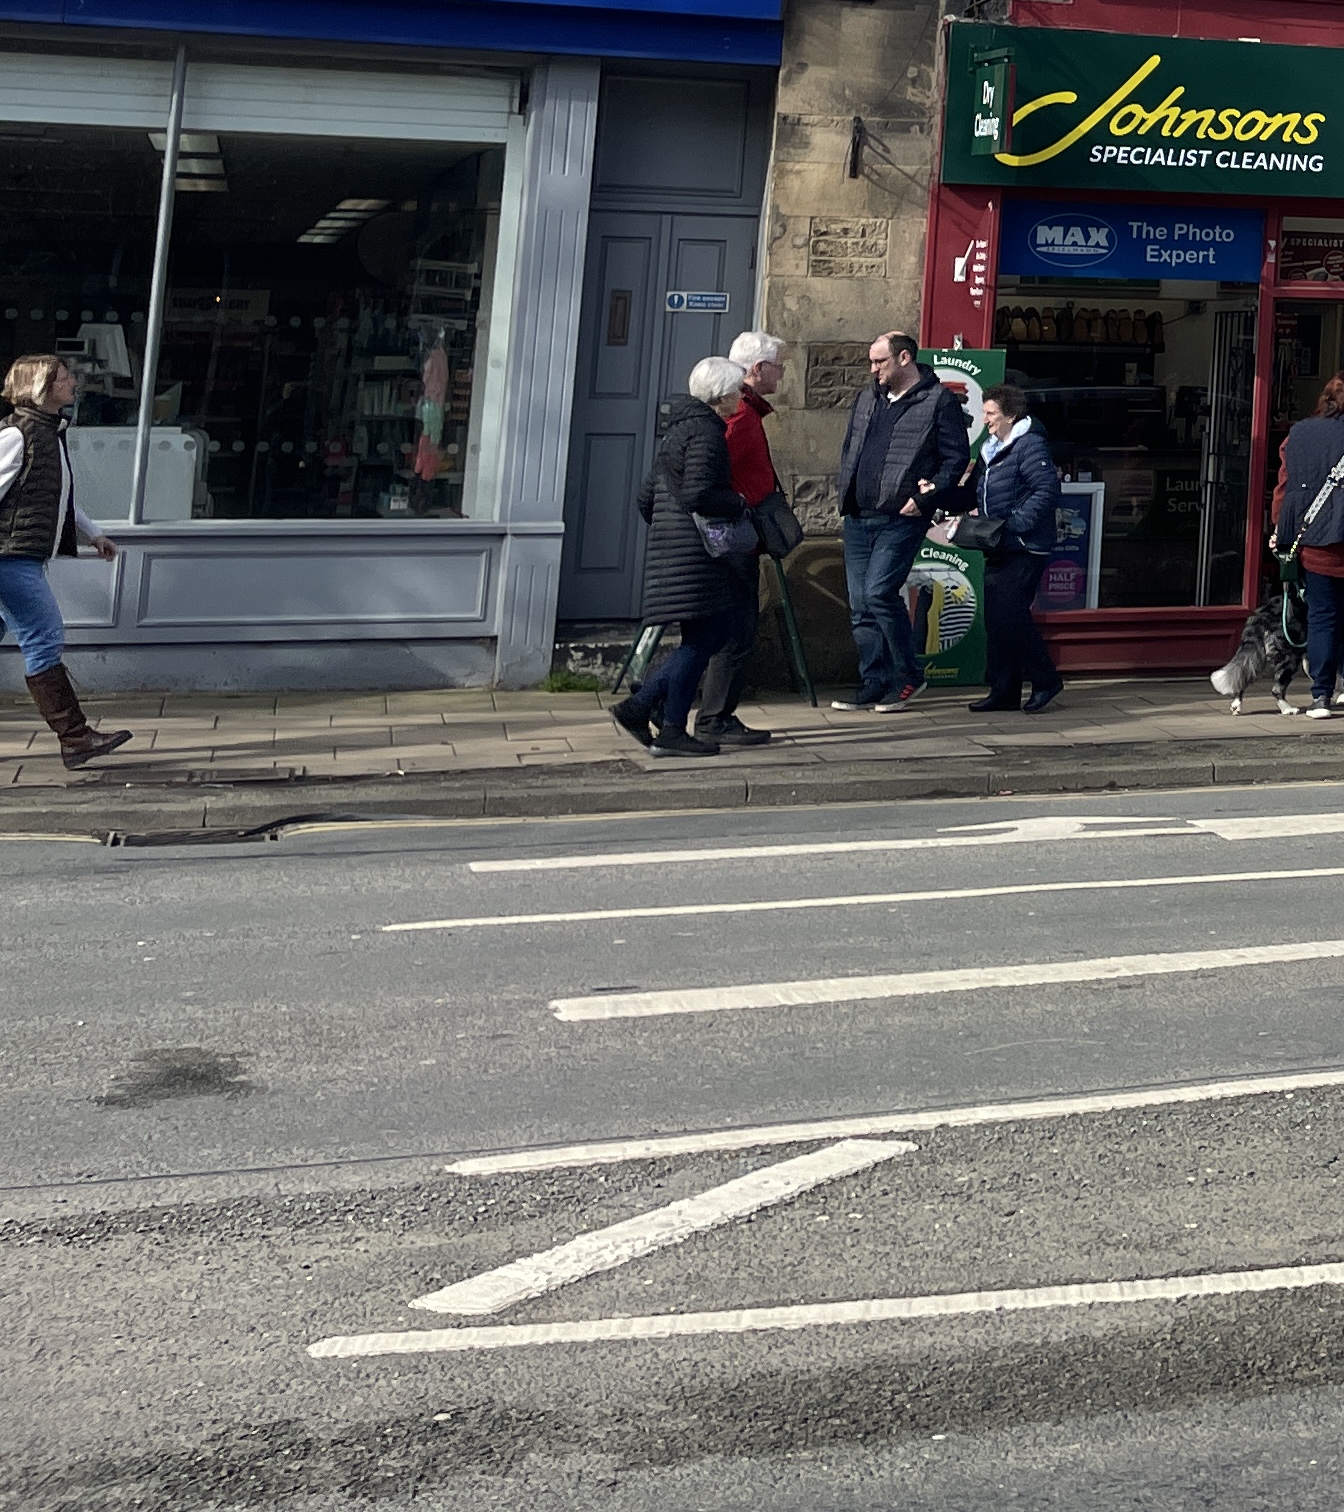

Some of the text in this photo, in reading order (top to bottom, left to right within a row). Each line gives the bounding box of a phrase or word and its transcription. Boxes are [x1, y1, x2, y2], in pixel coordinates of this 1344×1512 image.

[982, 80, 995, 109] Dry
[994, 54, 1325, 166] Johnsons
[1089, 145, 1324, 173] SPECIALIST CLEANING
[1036, 225, 1109, 247] MAX
[1128, 221, 1235, 243] The Photo
[1146, 245, 1216, 267] Expert
[933, 354, 982, 376] Laundry
[920, 548, 970, 572] Cleaning
[1049, 572, 1077, 582] HALF
[1049, 582, 1076, 591] PRICE
